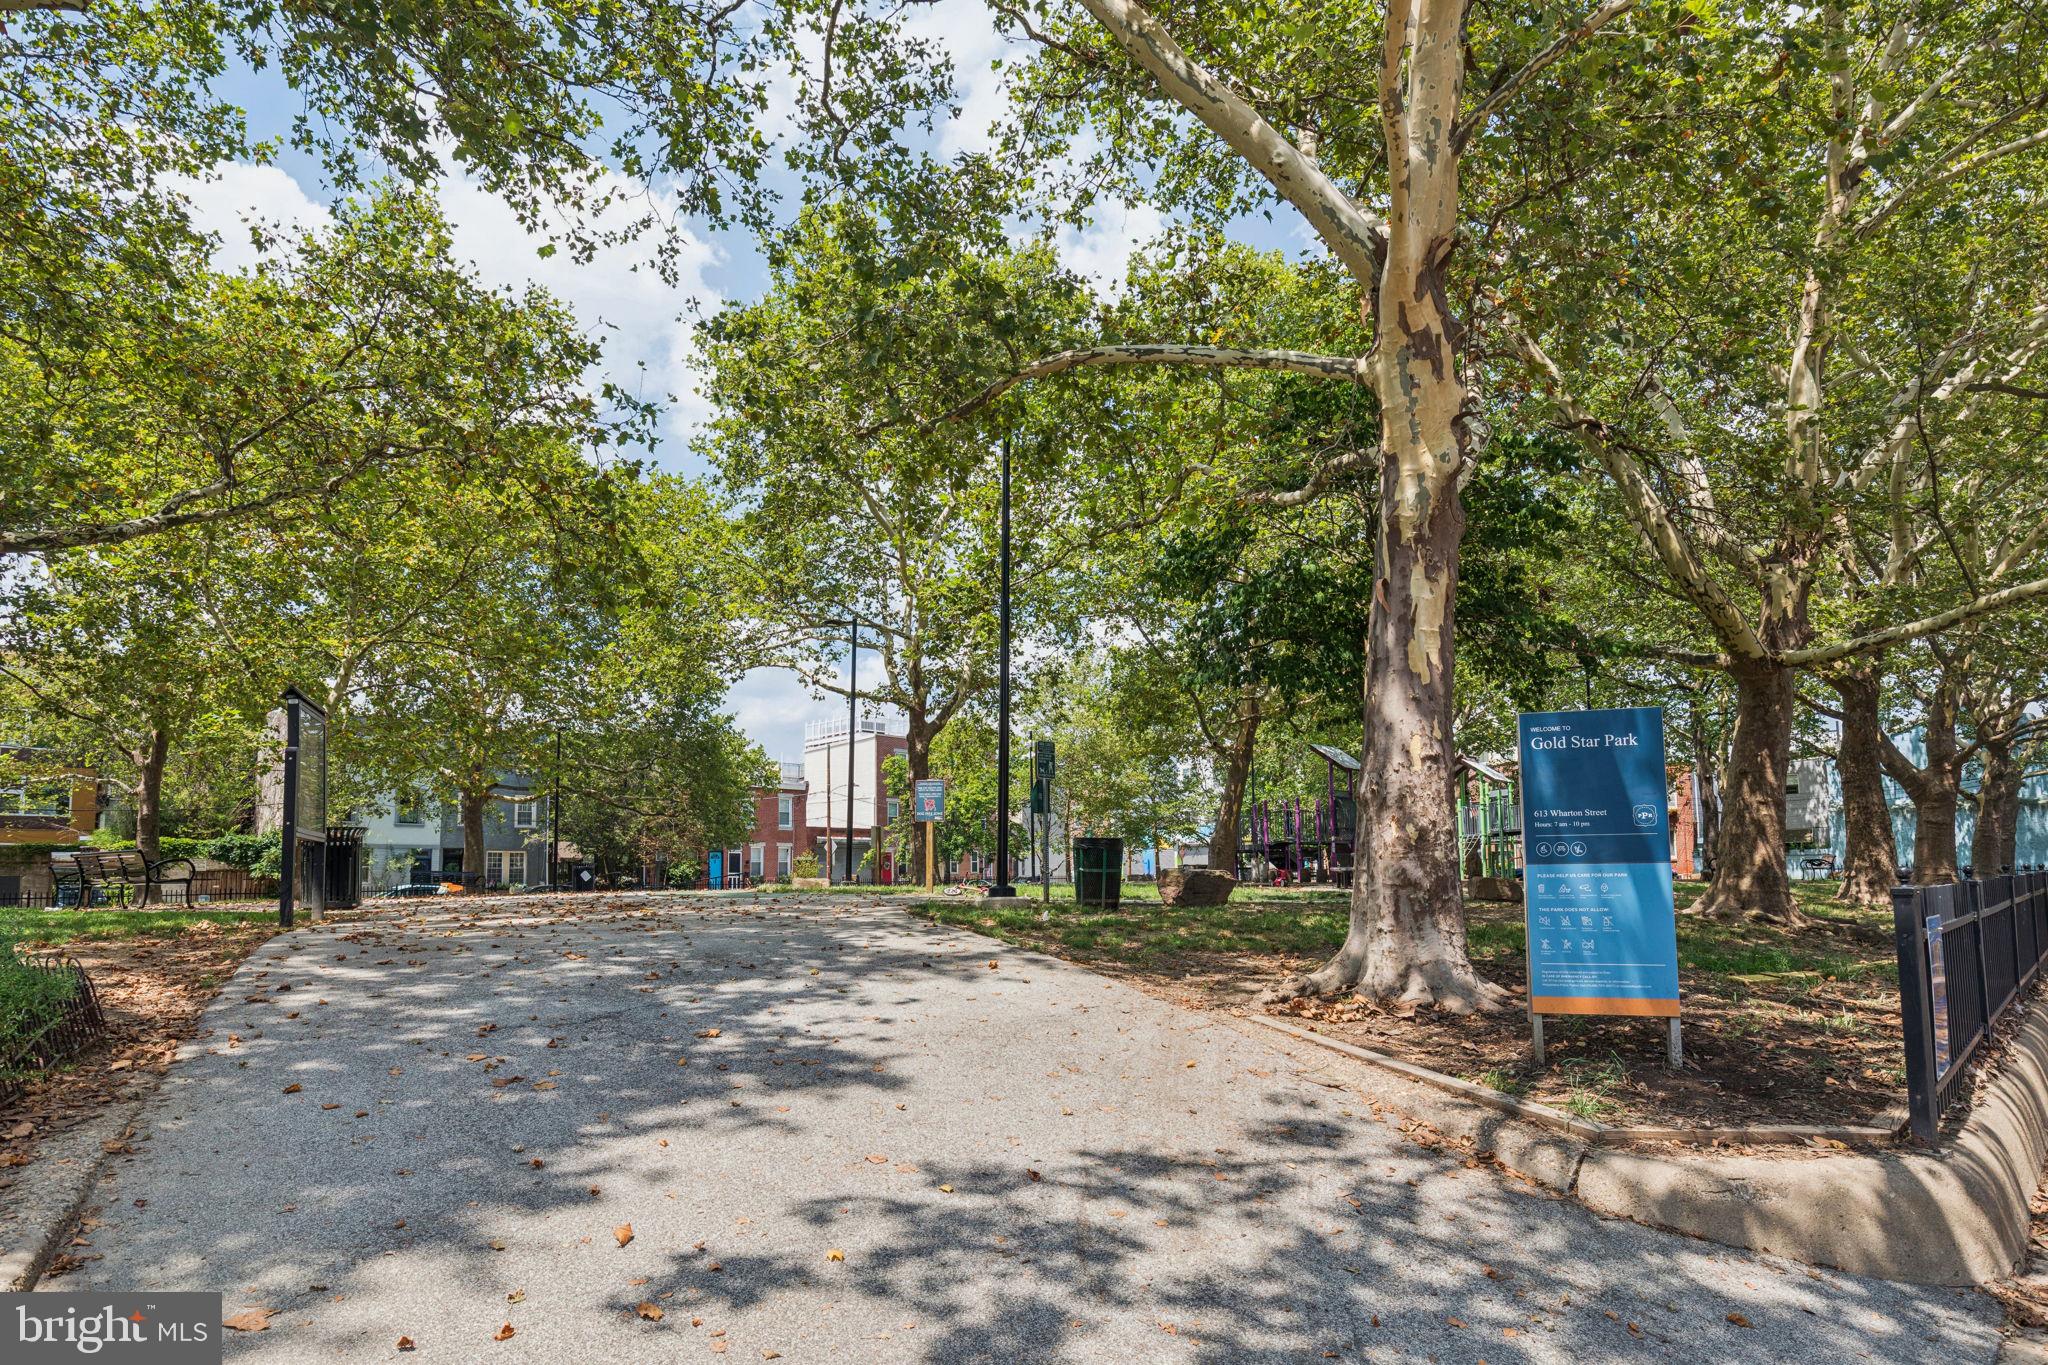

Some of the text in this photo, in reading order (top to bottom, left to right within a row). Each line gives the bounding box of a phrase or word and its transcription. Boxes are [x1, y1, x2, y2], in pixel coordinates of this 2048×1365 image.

[1531, 733, 1638, 750] Gold Star Park
[1534, 808, 1607, 818] 613 Wharton Street
